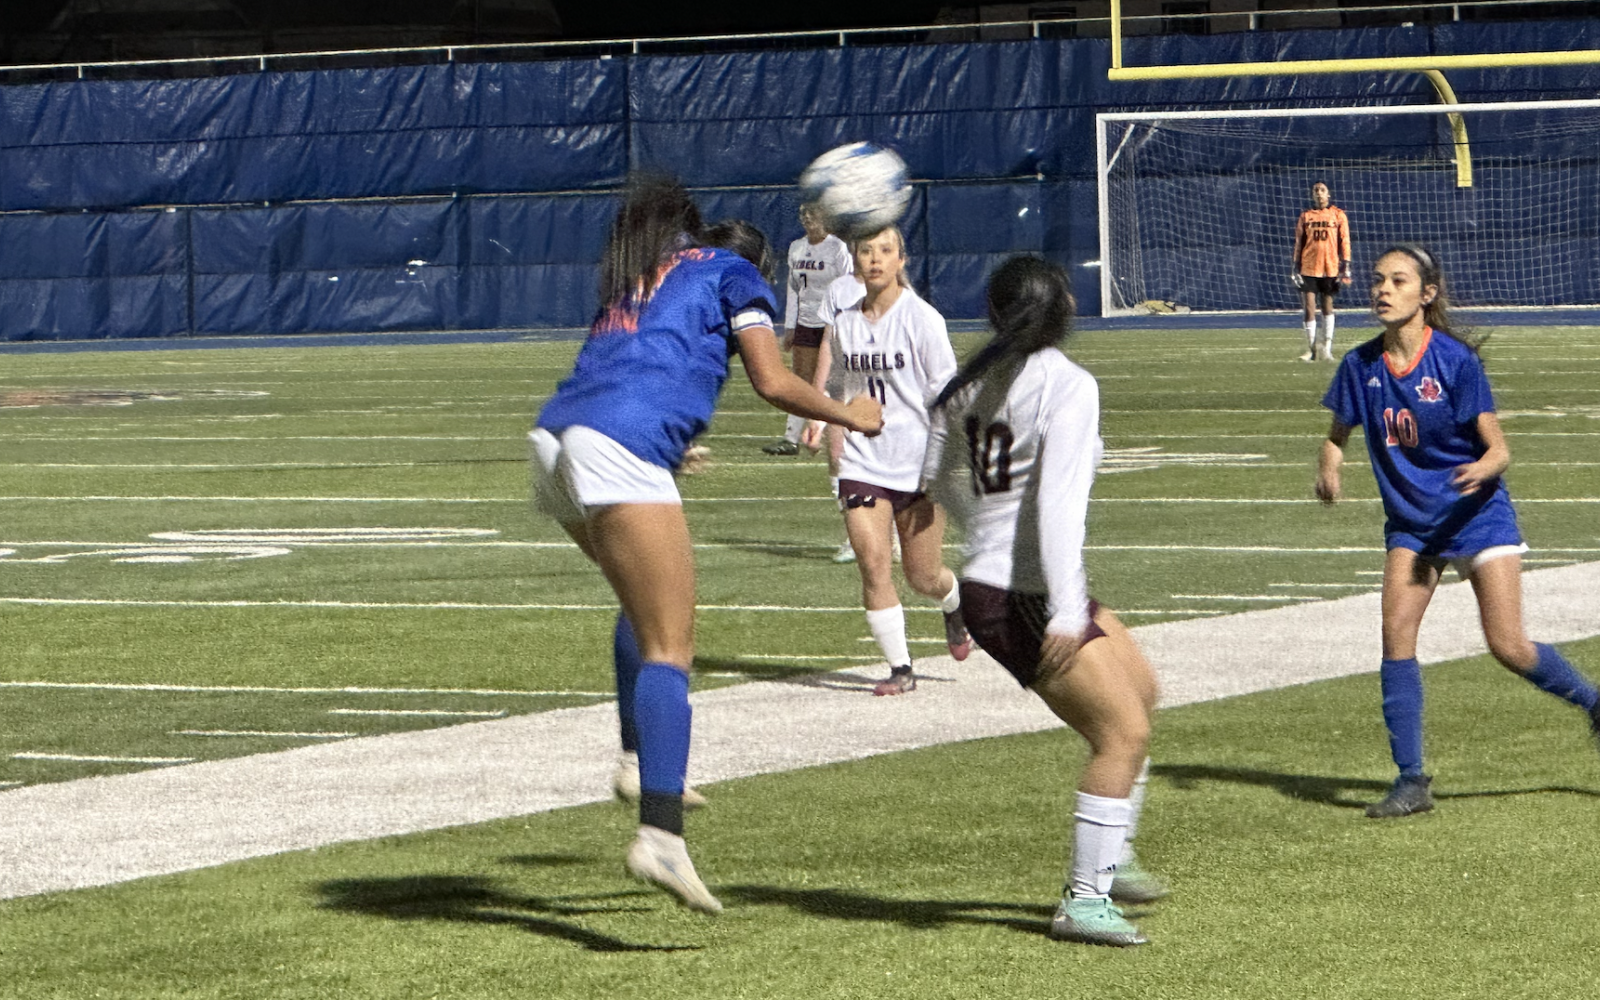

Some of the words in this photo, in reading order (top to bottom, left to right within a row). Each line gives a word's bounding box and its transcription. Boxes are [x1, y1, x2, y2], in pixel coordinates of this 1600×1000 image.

[1313, 229, 1328, 241] 00
[799, 272, 807, 289] 7
[1383, 407, 1418, 448] 10
[965, 415, 1014, 497] 10
